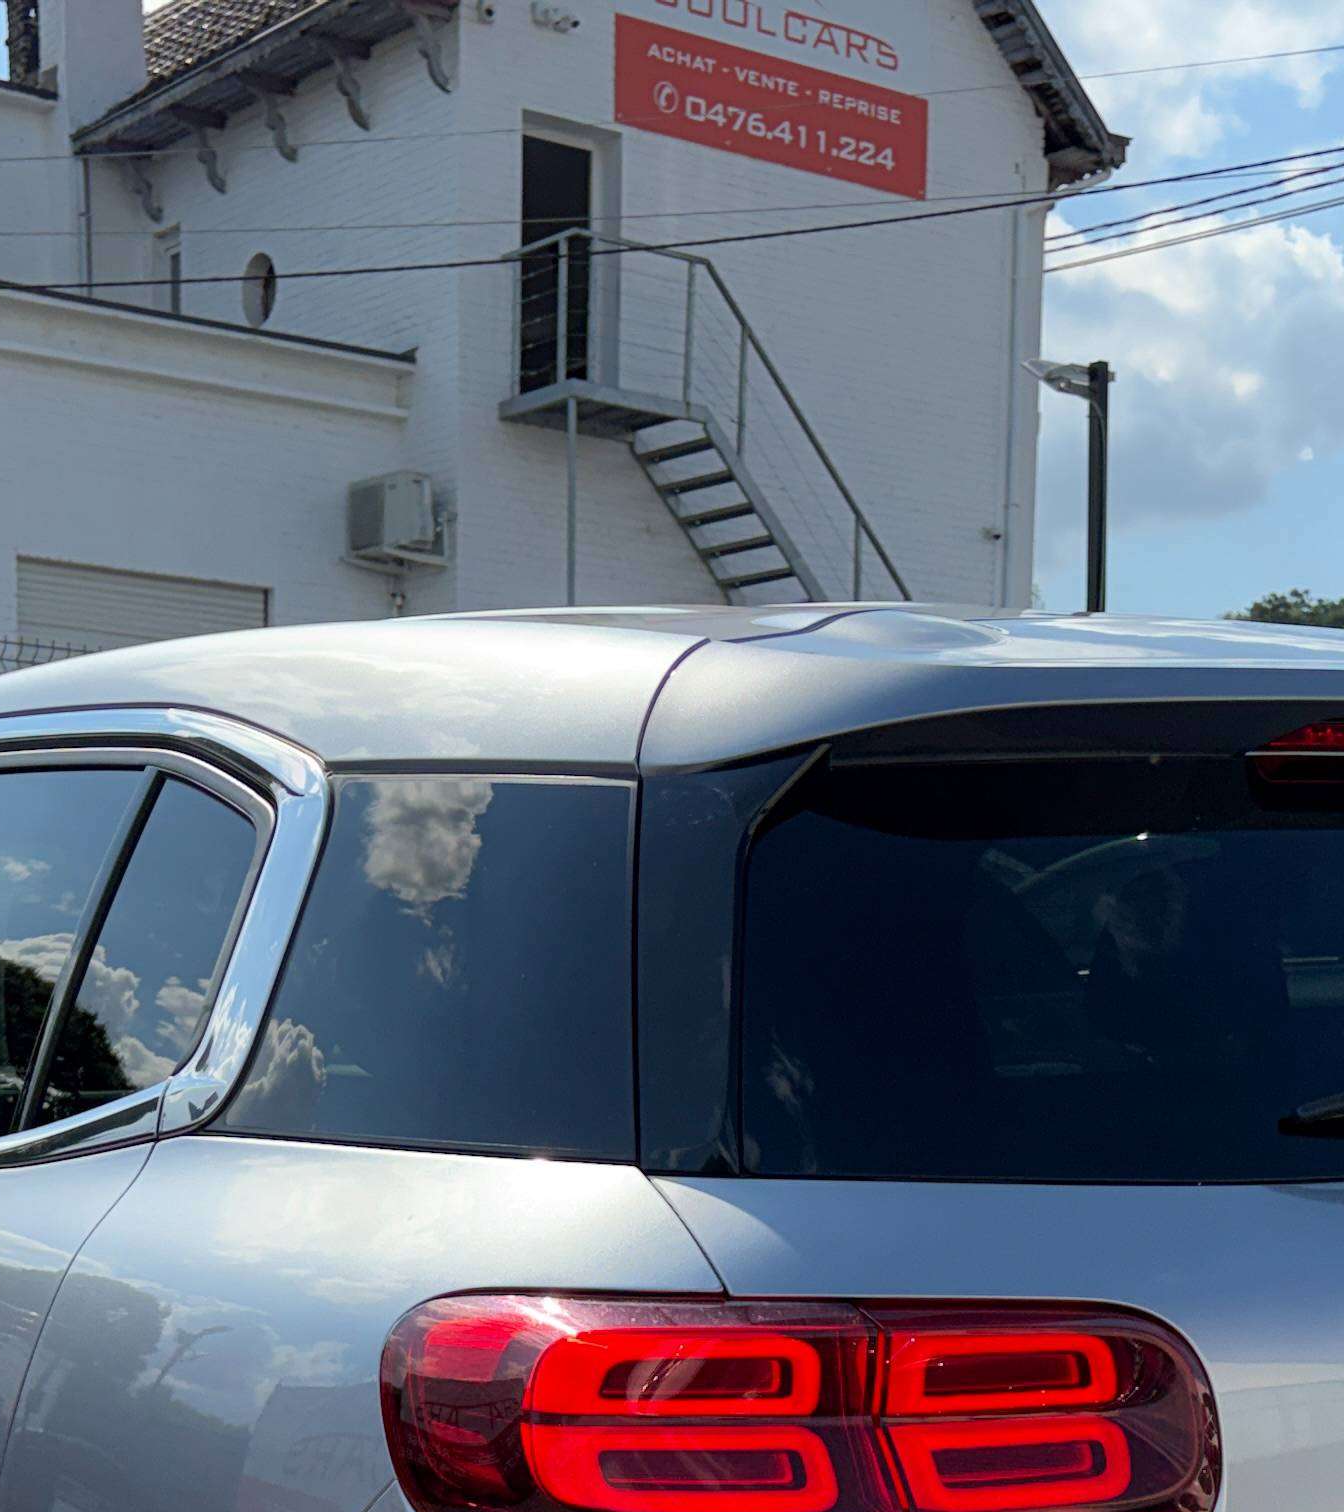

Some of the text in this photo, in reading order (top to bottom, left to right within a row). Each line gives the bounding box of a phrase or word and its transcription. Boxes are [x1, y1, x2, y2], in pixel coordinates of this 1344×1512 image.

[655, 0, 898, 71] OOLCARS
[647, 43, 901, 124] ACHAT VENTE REPRISE
[684, 96, 895, 171] 0476.411.224
